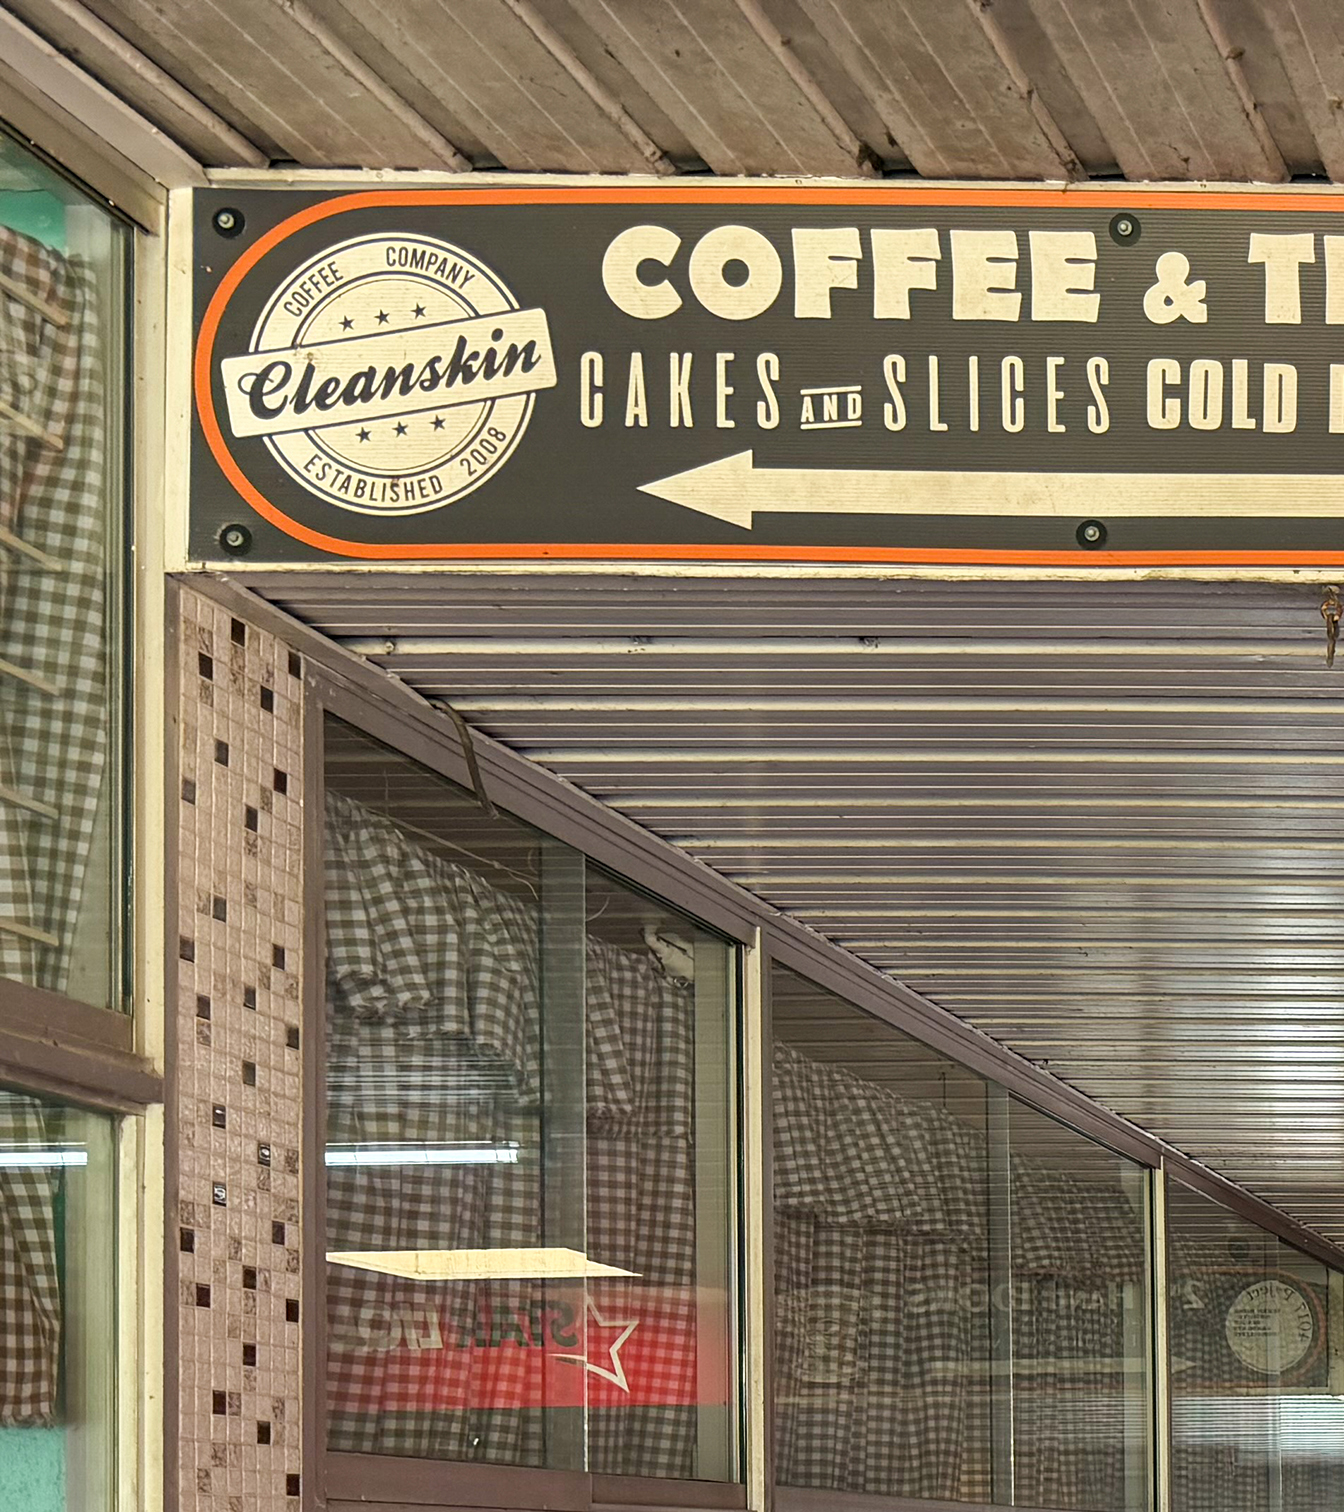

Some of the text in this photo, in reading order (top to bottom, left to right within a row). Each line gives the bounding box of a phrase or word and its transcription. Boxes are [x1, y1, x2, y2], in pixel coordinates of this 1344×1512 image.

[283, 245, 475, 318] COFFEE COMPANY
[601, 225, 1098, 321] COFFEE
[1143, 252, 1207, 324] &
[240, 326, 543, 420] Cleanskin
[579, 351, 780, 431] CAKES
[801, 392, 862, 425] AND
[883, 353, 1110, 434] SLICES
[1146, 357, 1297, 434] COLD
[302, 424, 508, 504] ESTABLISHED 2008
